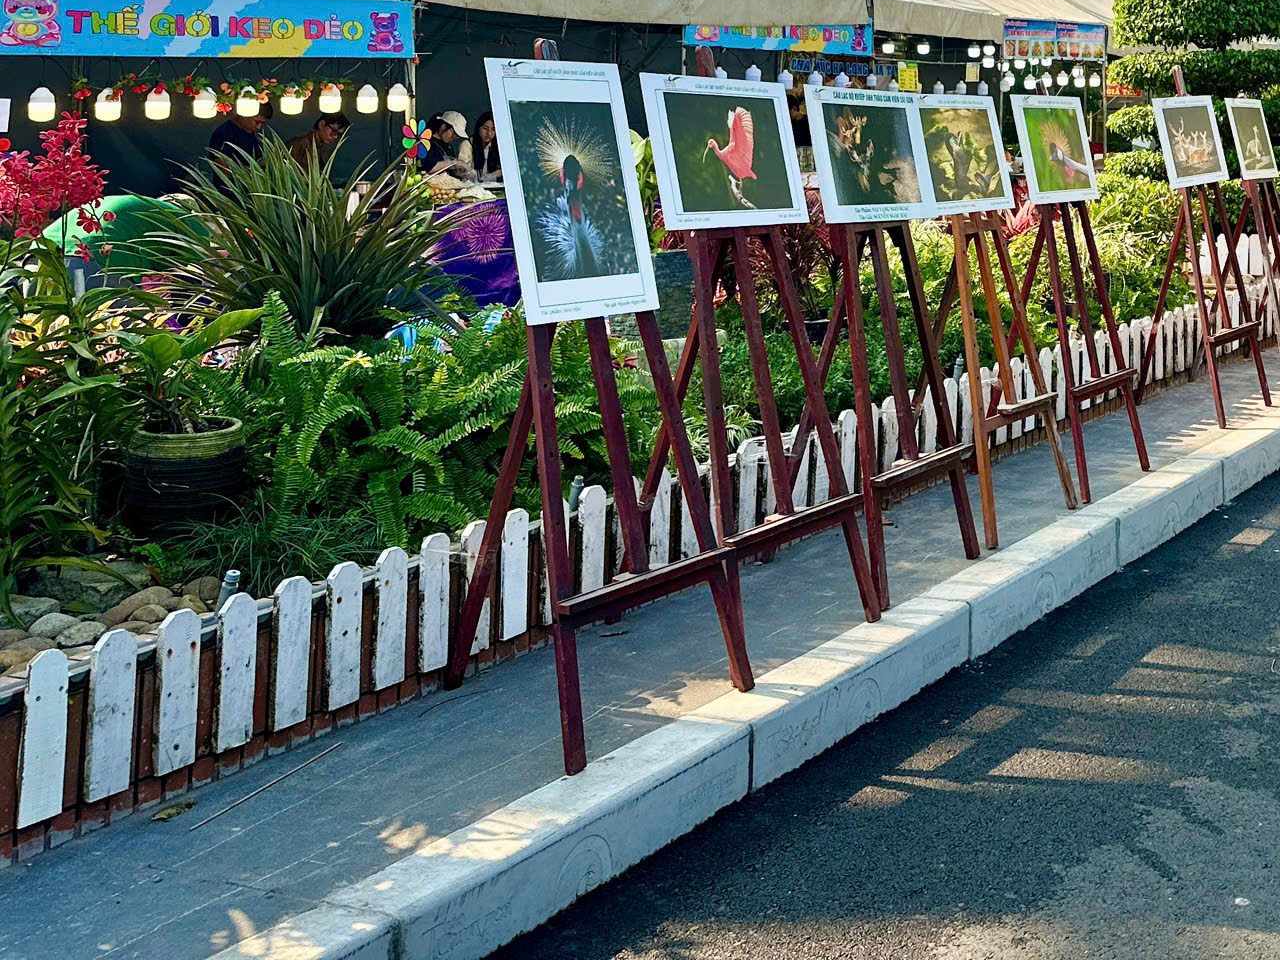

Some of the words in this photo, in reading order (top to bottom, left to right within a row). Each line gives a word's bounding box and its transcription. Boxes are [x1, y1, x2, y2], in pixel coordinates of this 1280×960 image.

[66, 4, 140, 35] THẾ
[150, 10, 219, 37] GIỚI
[229, 16, 295, 43] KẸO
[303, 13, 364, 41] DẺO
